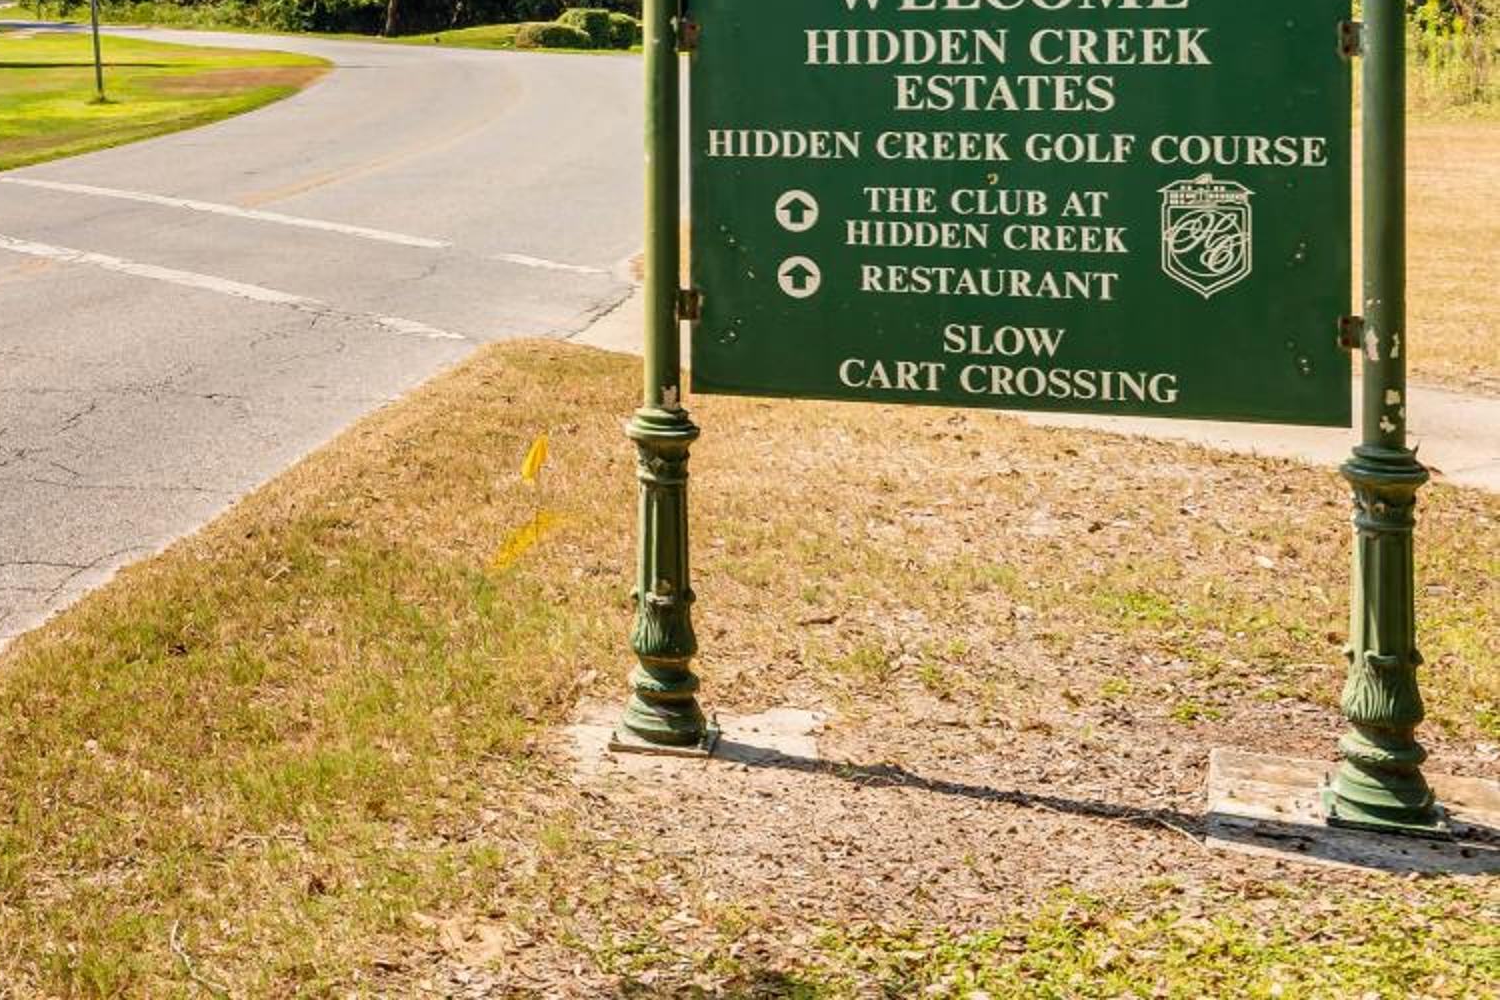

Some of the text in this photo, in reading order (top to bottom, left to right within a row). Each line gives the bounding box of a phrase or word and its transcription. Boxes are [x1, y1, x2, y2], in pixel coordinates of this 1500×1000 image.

[803, 28, 1212, 65] HIDDEN CREEK
[894, 74, 1116, 113] ESTATES
[706, 129, 1329, 167] HIDDEN CREEK GOLF COURSE
[863, 186, 1109, 219] THE CLUB AT
[844, 219, 1129, 254] HIDDEN CREEK
[860, 265, 1119, 302] RESTAURANT
[943, 323, 1066, 357] SLOW
[839, 358, 1180, 404] CART CROSSING
